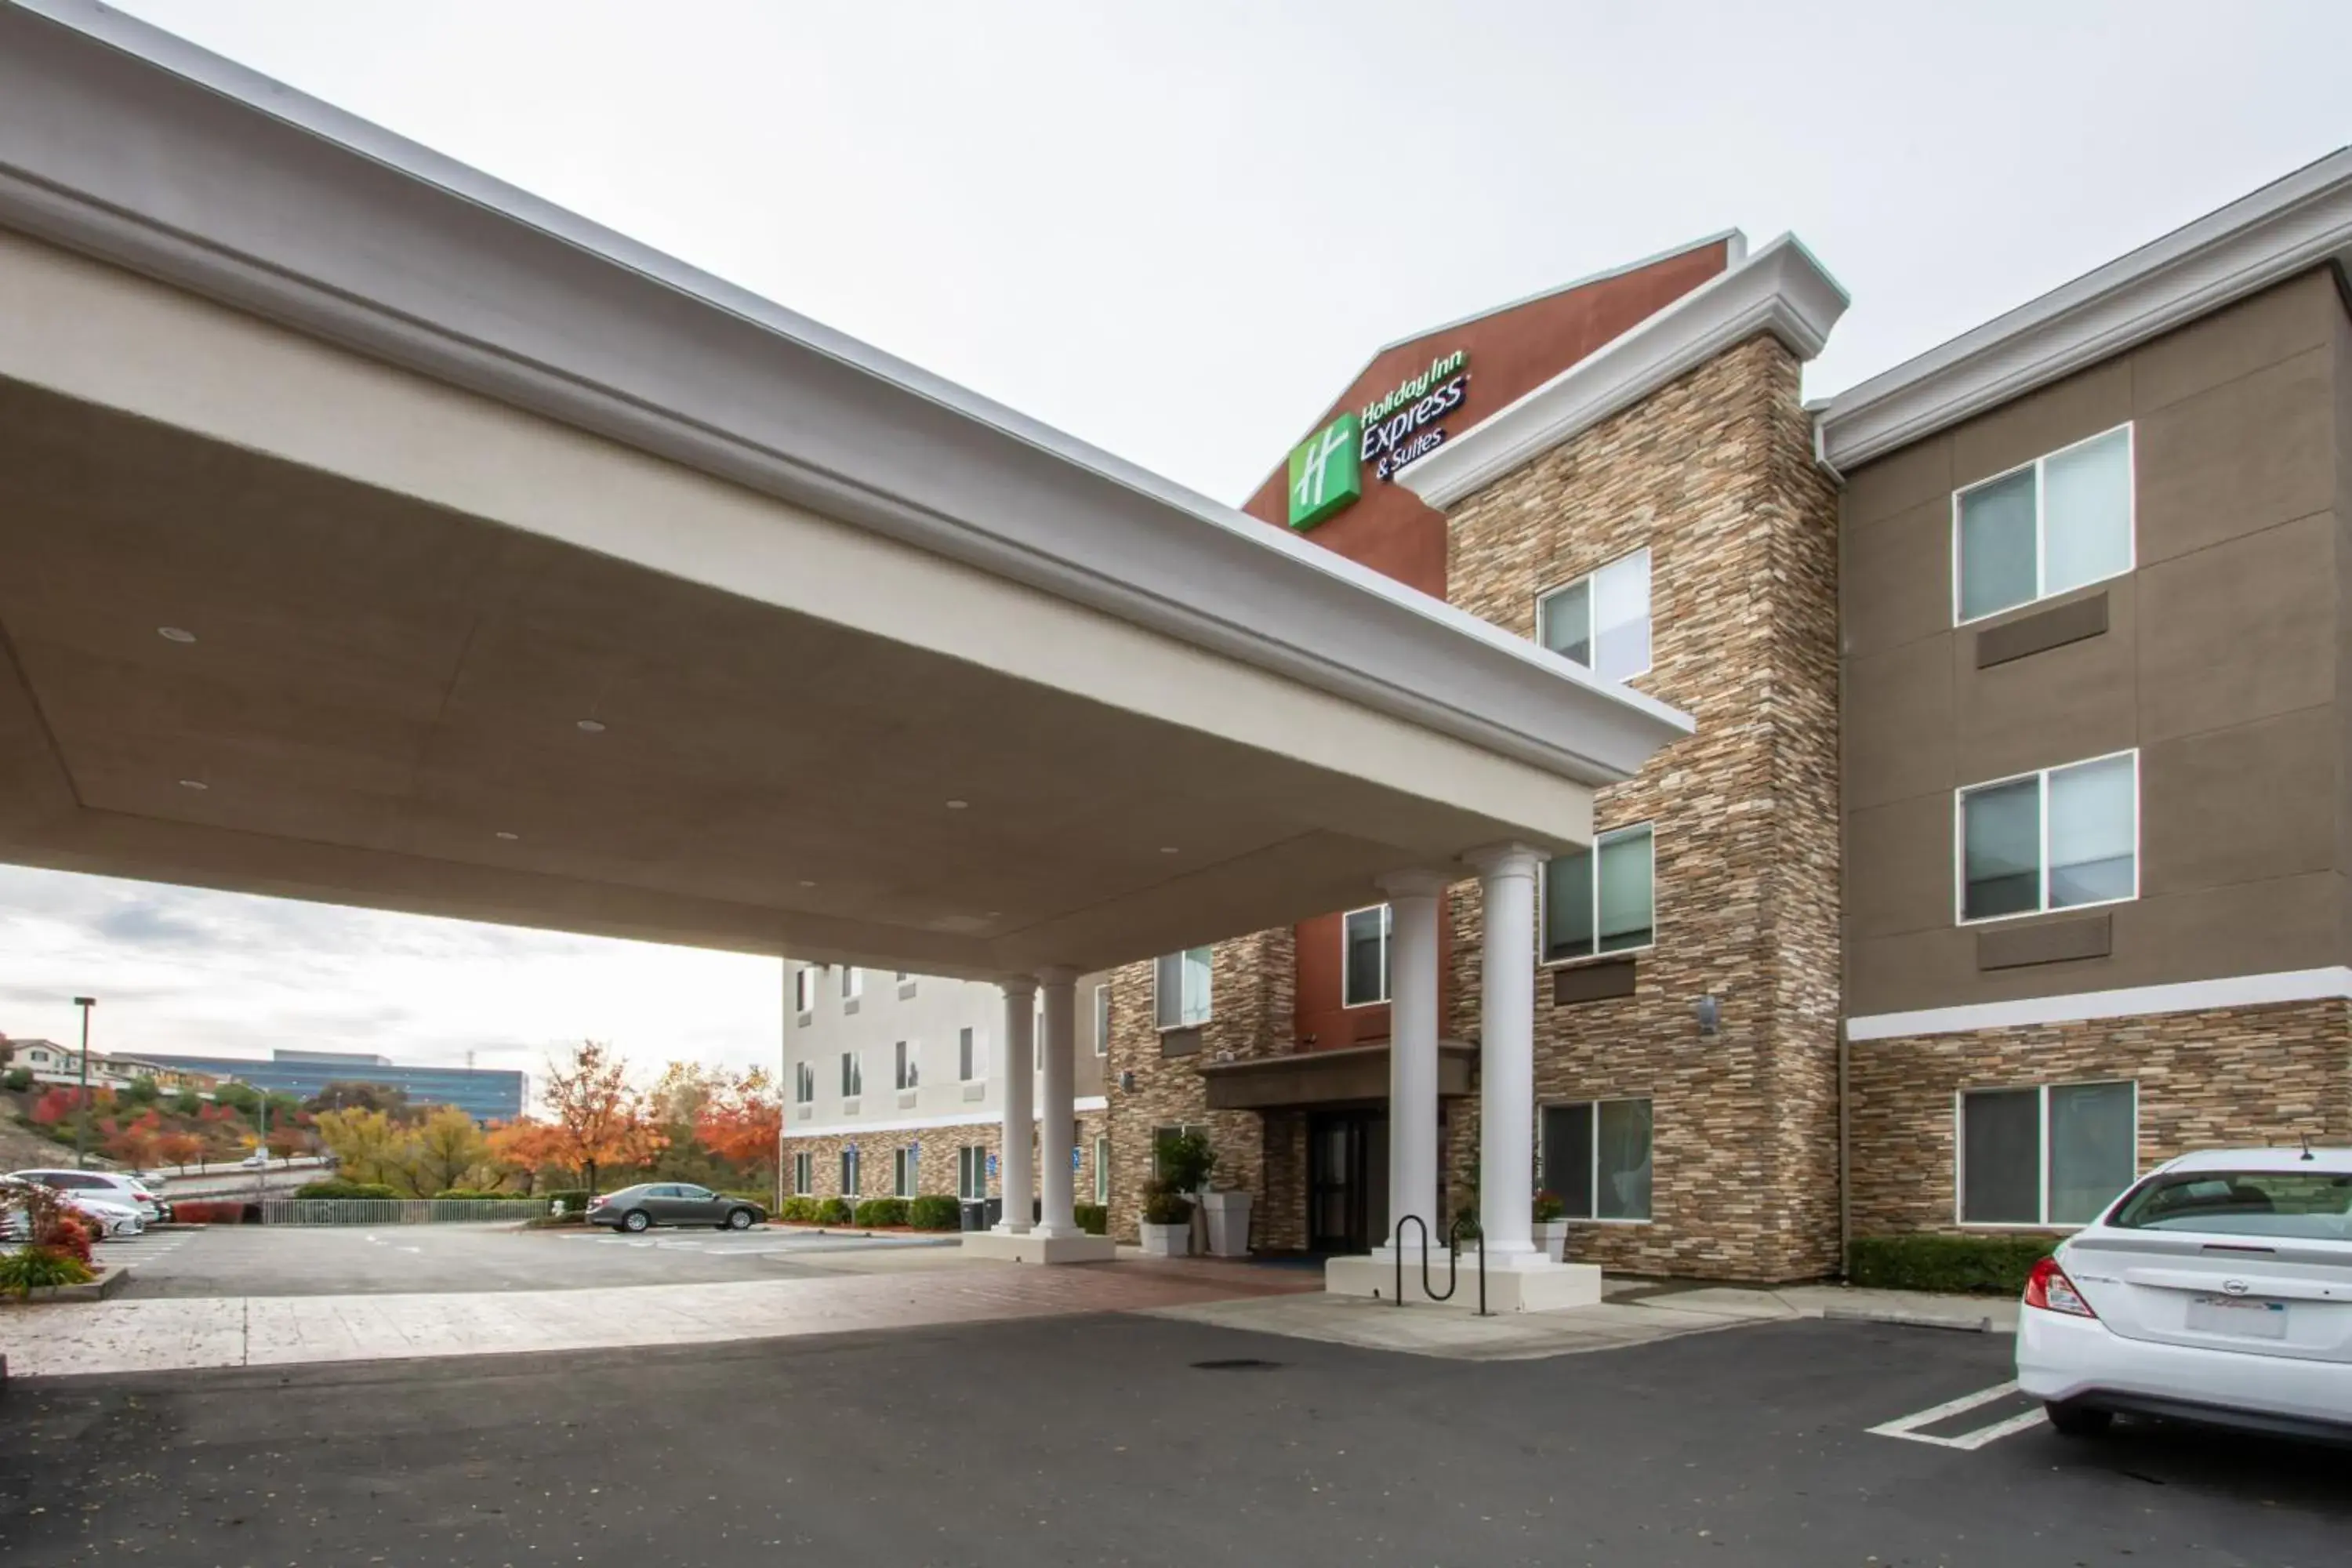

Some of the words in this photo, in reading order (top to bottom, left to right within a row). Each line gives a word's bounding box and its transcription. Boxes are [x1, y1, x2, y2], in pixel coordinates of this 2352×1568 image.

[1361, 371, 1429, 429] Holiday
[1431, 350, 1463, 383] Inn
[1361, 375, 1462, 461] Express
[1376, 457, 1390, 480] &
[1390, 427, 1443, 470] Suites
